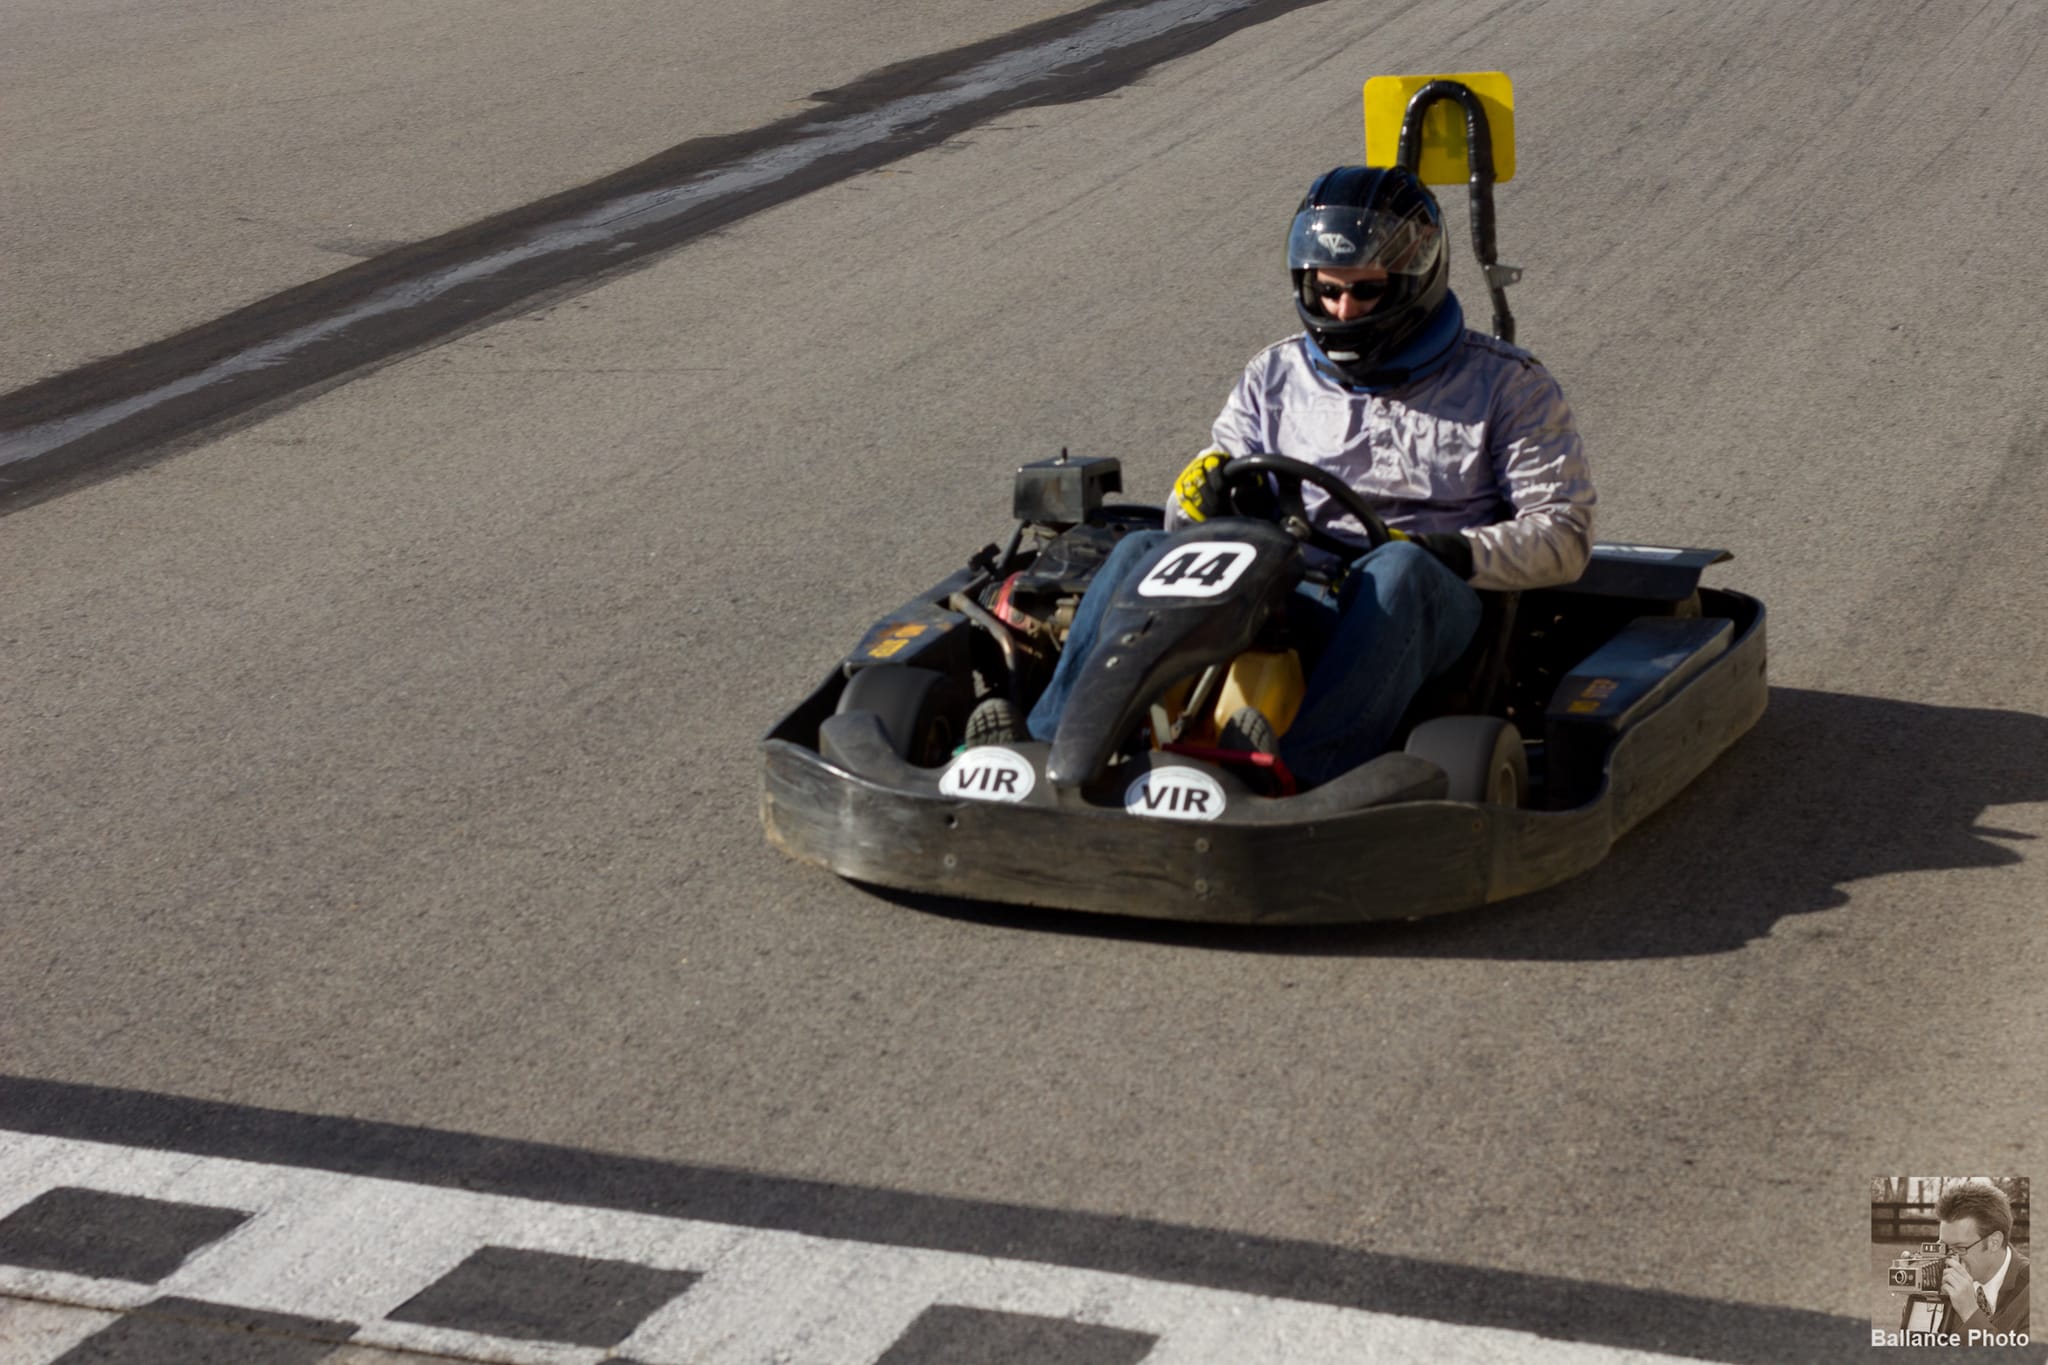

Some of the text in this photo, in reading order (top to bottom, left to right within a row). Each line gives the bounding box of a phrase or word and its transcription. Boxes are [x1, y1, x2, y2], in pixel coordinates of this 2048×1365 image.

[1151, 552, 1240, 586] 44
[959, 767, 1019, 794] VIR
[1142, 785, 1210, 813] VIR
